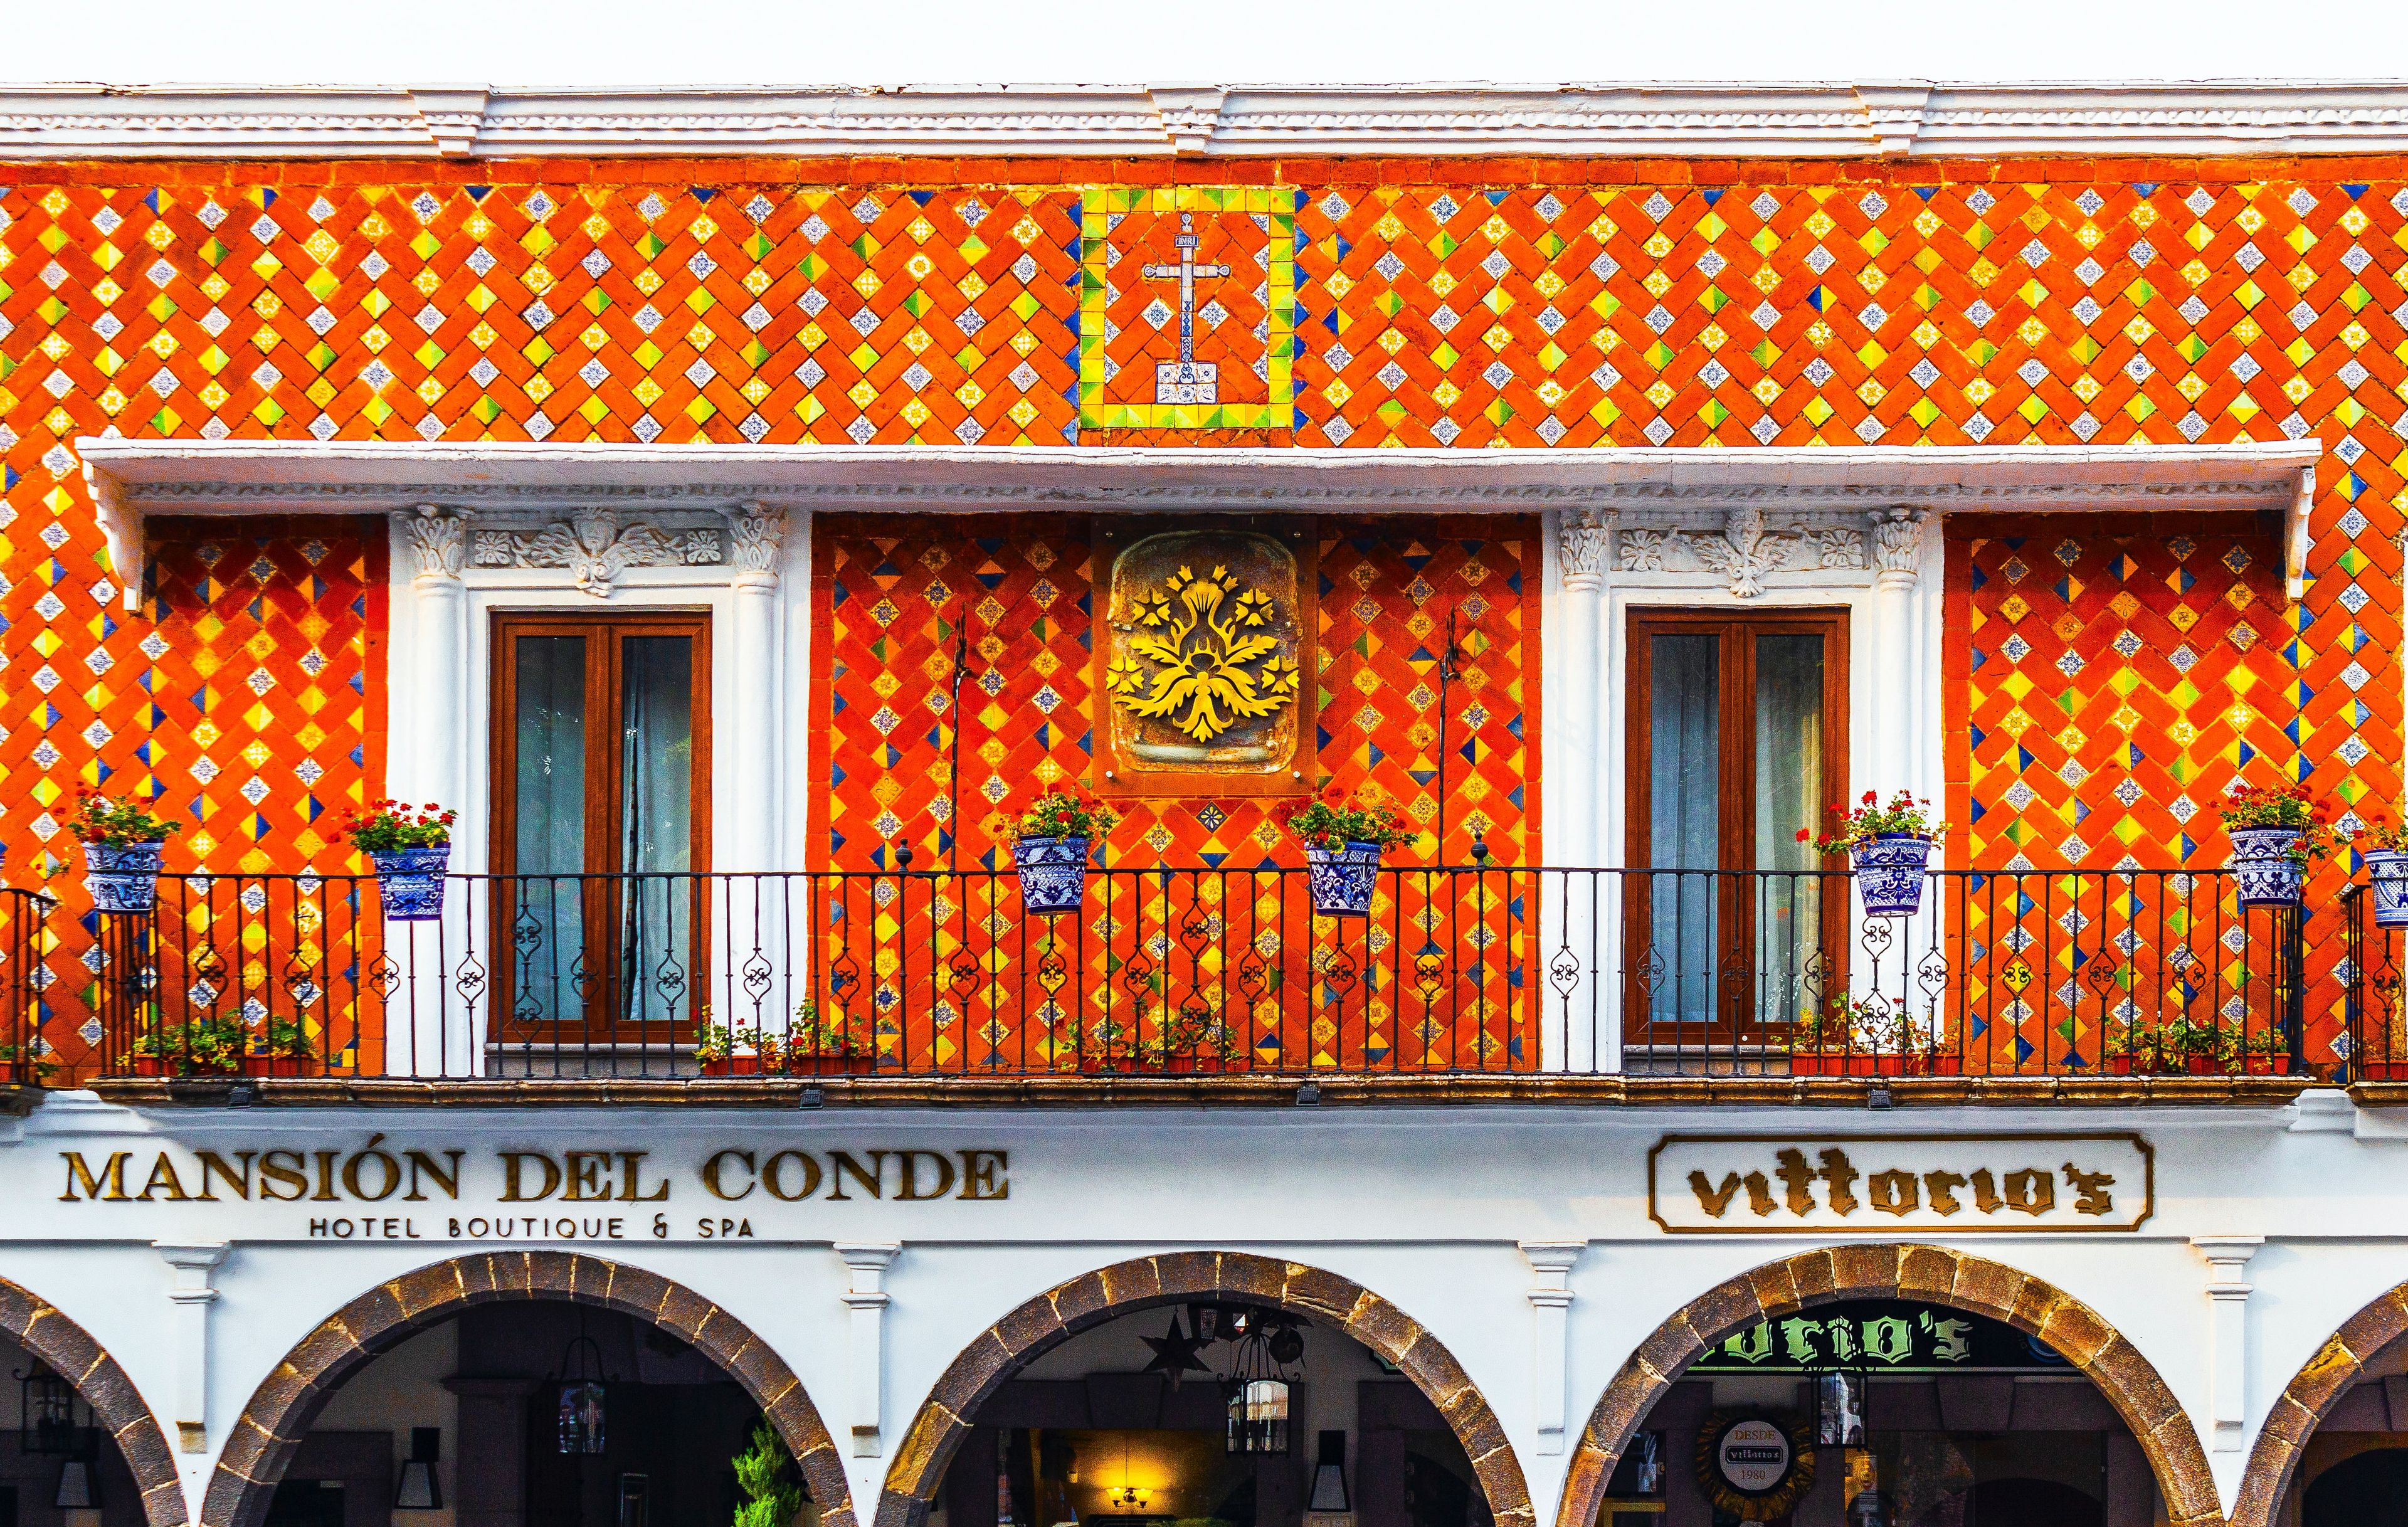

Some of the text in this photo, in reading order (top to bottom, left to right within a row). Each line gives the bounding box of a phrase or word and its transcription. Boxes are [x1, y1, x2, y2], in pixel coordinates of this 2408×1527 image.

[58, 1133, 1009, 1202] MANSIÓN DEL CONDE
[1687, 1147, 2116, 1218] vittorio's
[310, 1212, 754, 1239] HOTEL BOUTIQUE & SPA
[1698, 1309, 1974, 1364] orio's
[1735, 1430, 1776, 1440] DESDE
[1741, 1470, 1766, 1480] 1980
